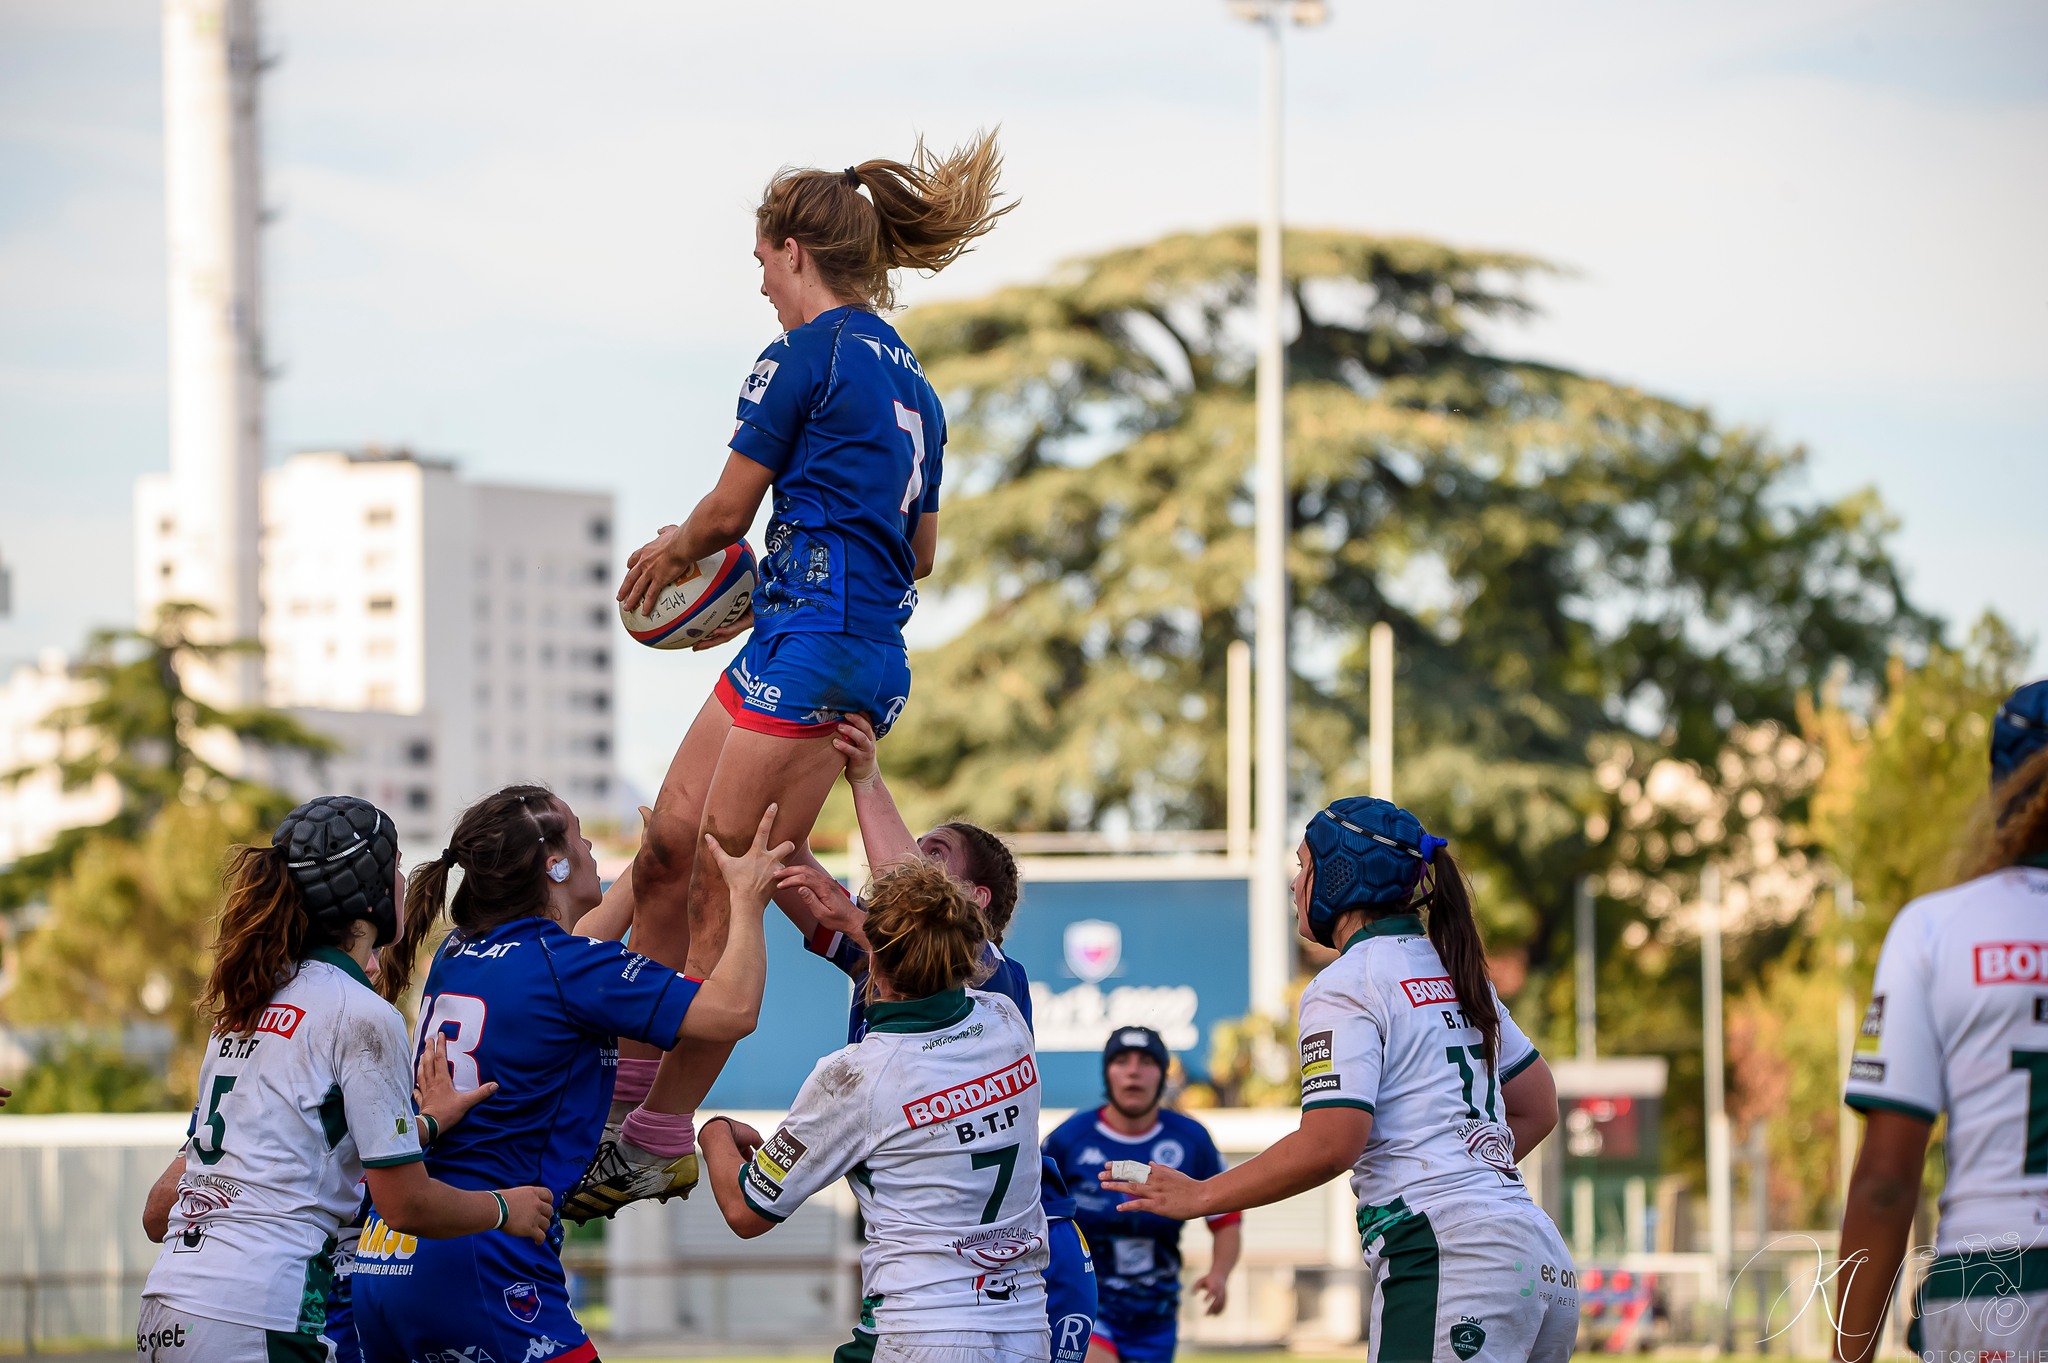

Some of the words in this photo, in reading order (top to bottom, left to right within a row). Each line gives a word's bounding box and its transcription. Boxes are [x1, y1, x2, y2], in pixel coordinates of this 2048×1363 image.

[893, 399, 924, 515] 7
[192, 1075, 238, 1166] 5
[908, 1060, 1033, 1127] BORDATTO
[955, 1105, 1020, 1145] B.T.P
[971, 1142, 1021, 1225] 7
[1059, 1317, 1084, 1351] R
[1461, 1315, 1483, 1326] PAU
